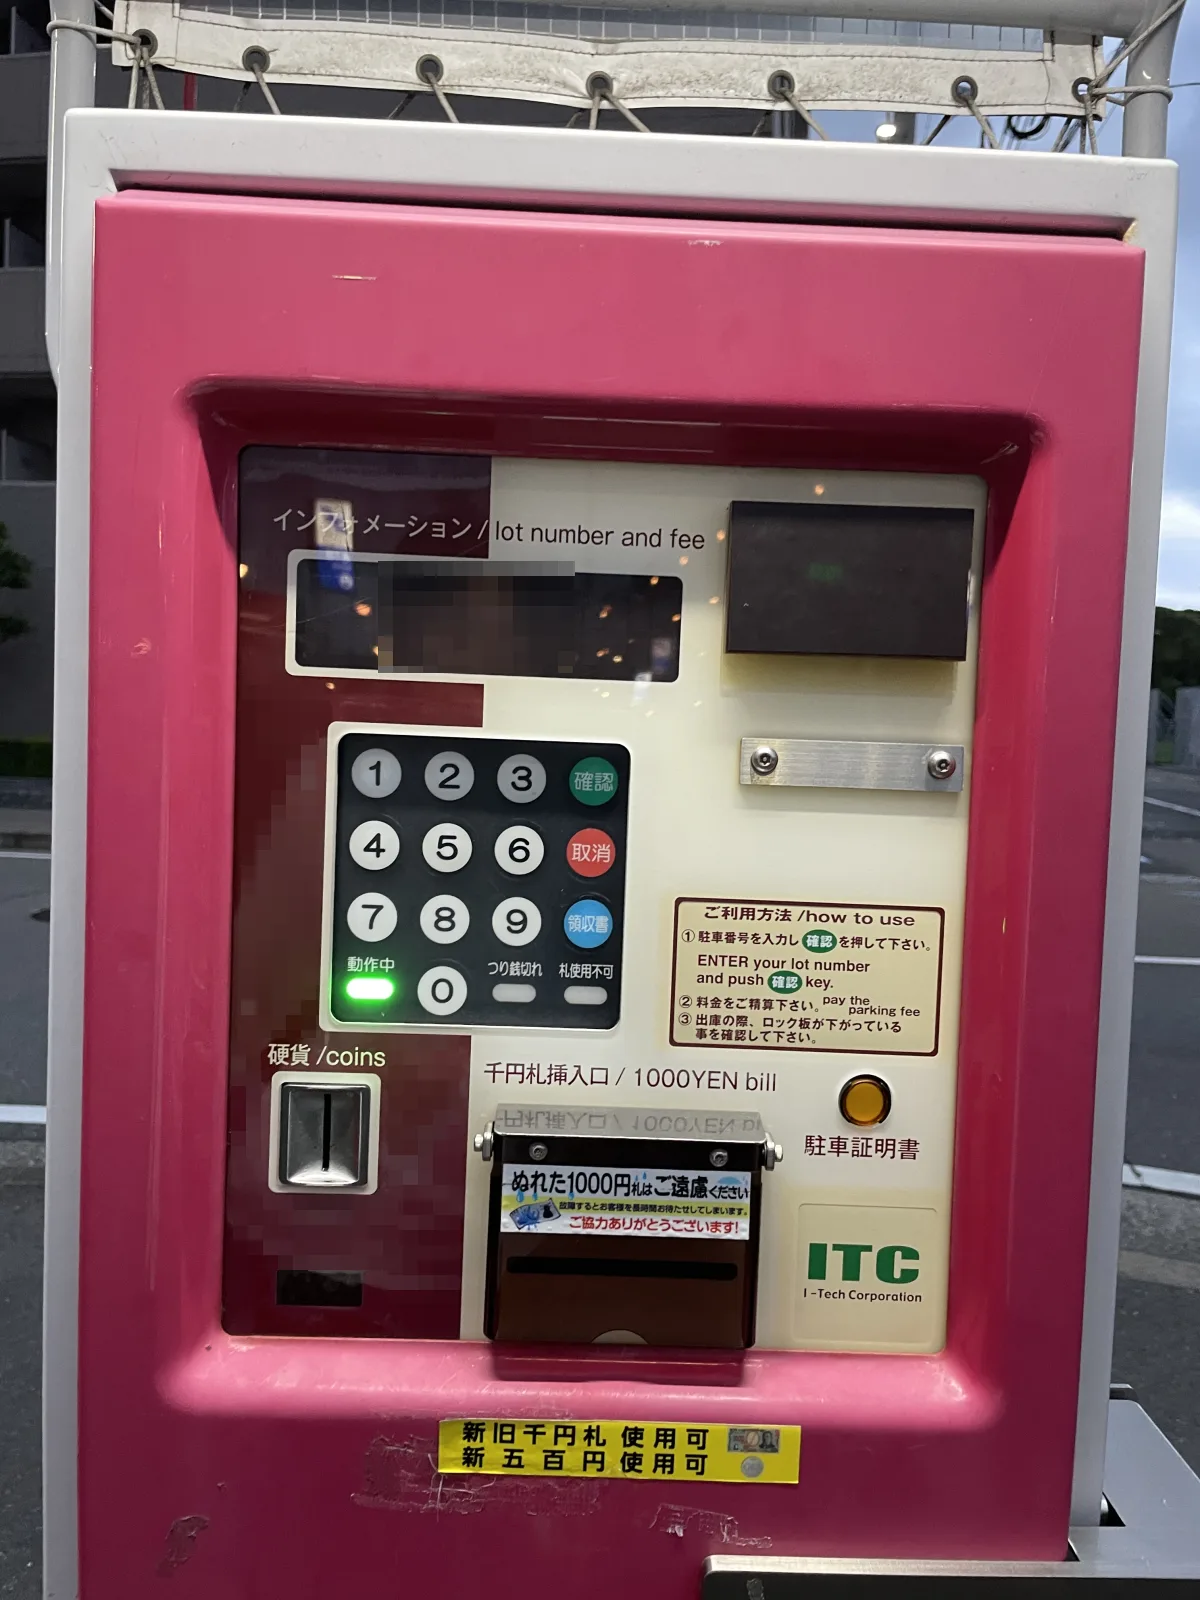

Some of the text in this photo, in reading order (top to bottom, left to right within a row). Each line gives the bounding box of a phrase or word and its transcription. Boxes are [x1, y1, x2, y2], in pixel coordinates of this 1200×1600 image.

[495, 520, 524, 542] lot
[531, 525, 615, 546] number
[621, 528, 662, 548] and
[670, 528, 705, 550] fee
[368, 760, 382, 787] 1
[438, 763, 461, 790] 2
[510, 765, 533, 792] 3
[573, 771, 614, 792] 確認
[363, 832, 386, 858] 4
[435, 834, 459, 861] 5
[508, 837, 531, 863] 6
[571, 843, 611, 863] 取消
[361, 904, 384, 930] 7
[433, 906, 456, 932] 8
[505, 908, 528, 935] 9
[567, 914, 610, 934] 領収書
[704, 905, 792, 922] ご利用方法
[854, 912, 874, 925] to
[880, 915, 915, 926] use
[346, 955, 396, 972] 動作中
[487, 960, 543, 978] つり銭切れ
[558, 962, 614, 980] 札使用不可
[697, 954, 870, 972] ENTER your lot number
[431, 977, 454, 1004] 0
[696, 972, 724, 984] and
[728, 974, 764, 987] push
[805, 975, 834, 991] key.
[822, 995, 870, 1006] pay the
[848, 1005, 920, 1017] parking fee
[695, 1028, 816, 1045] 事を確認して下さい。
[267, 1043, 311, 1066] 硬貨
[483, 1062, 609, 1086] 千円札挿入口
[634, 1068, 739, 1090] 1000YEN
[745, 1072, 777, 1092] bill
[804, 1135, 920, 1160] 駐車証明書
[808, 1243, 920, 1284] ITC
[849, 1290, 922, 1303] Corporation
